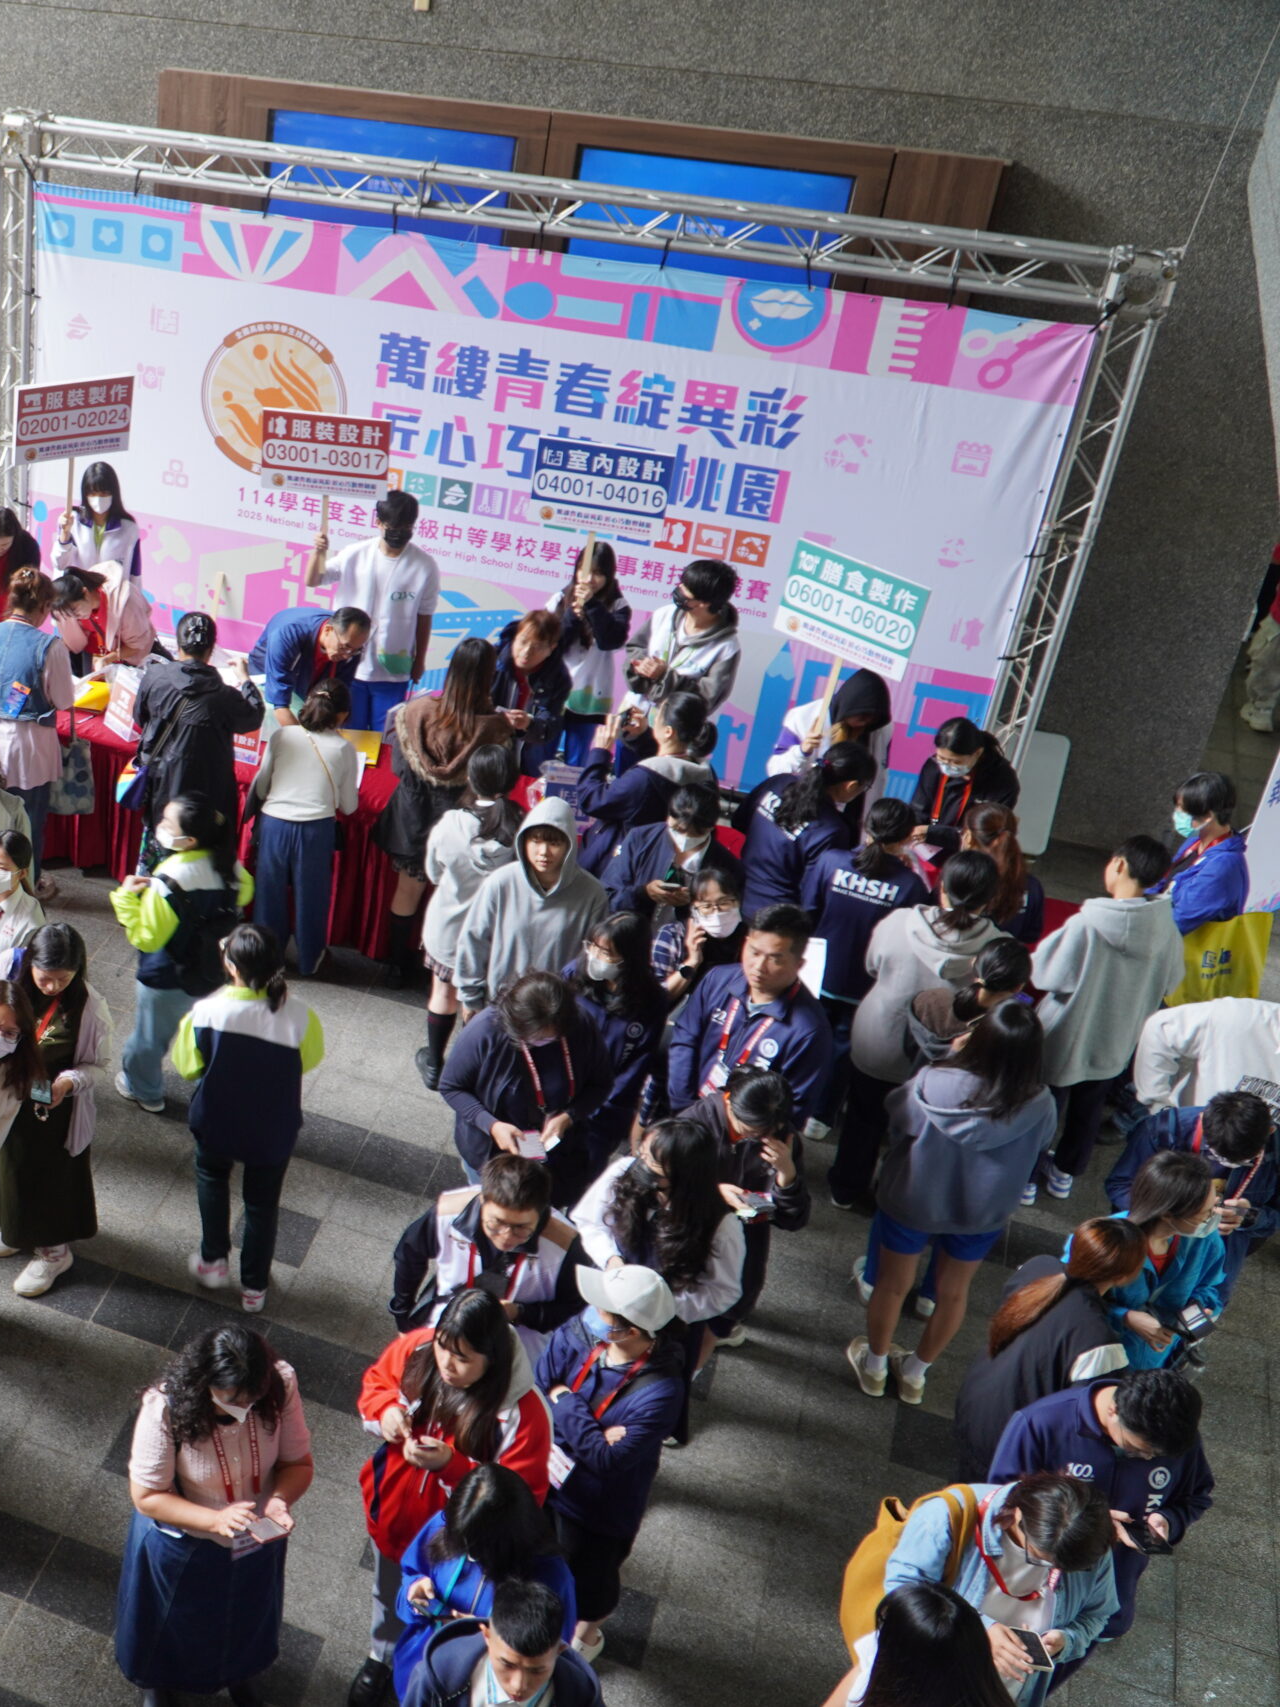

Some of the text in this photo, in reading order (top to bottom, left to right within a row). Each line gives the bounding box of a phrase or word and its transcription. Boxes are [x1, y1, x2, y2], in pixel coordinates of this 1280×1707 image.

[45, 384, 128, 410] 服裝製作
[376, 332, 809, 450] 萬縷青春綻異彩
[19, 410, 128, 437] 02001-02024
[292, 419, 384, 446] 服裝設計
[265, 442, 385, 471] 03001-03017
[371, 401, 791, 524] 匠心巧桃園
[566, 449, 665, 482] 室內設計
[536, 473, 665, 508] 04001-04016
[237, 509, 262, 520] 2025
[266, 514, 304, 528] National
[455, 551, 477, 562] High
[480, 556, 513, 568] School
[517, 563, 560, 578] Students
[821, 559, 919, 614] 膳食製作
[788, 578, 912, 644] 06001-06020
[832, 868, 900, 902] KHSH
